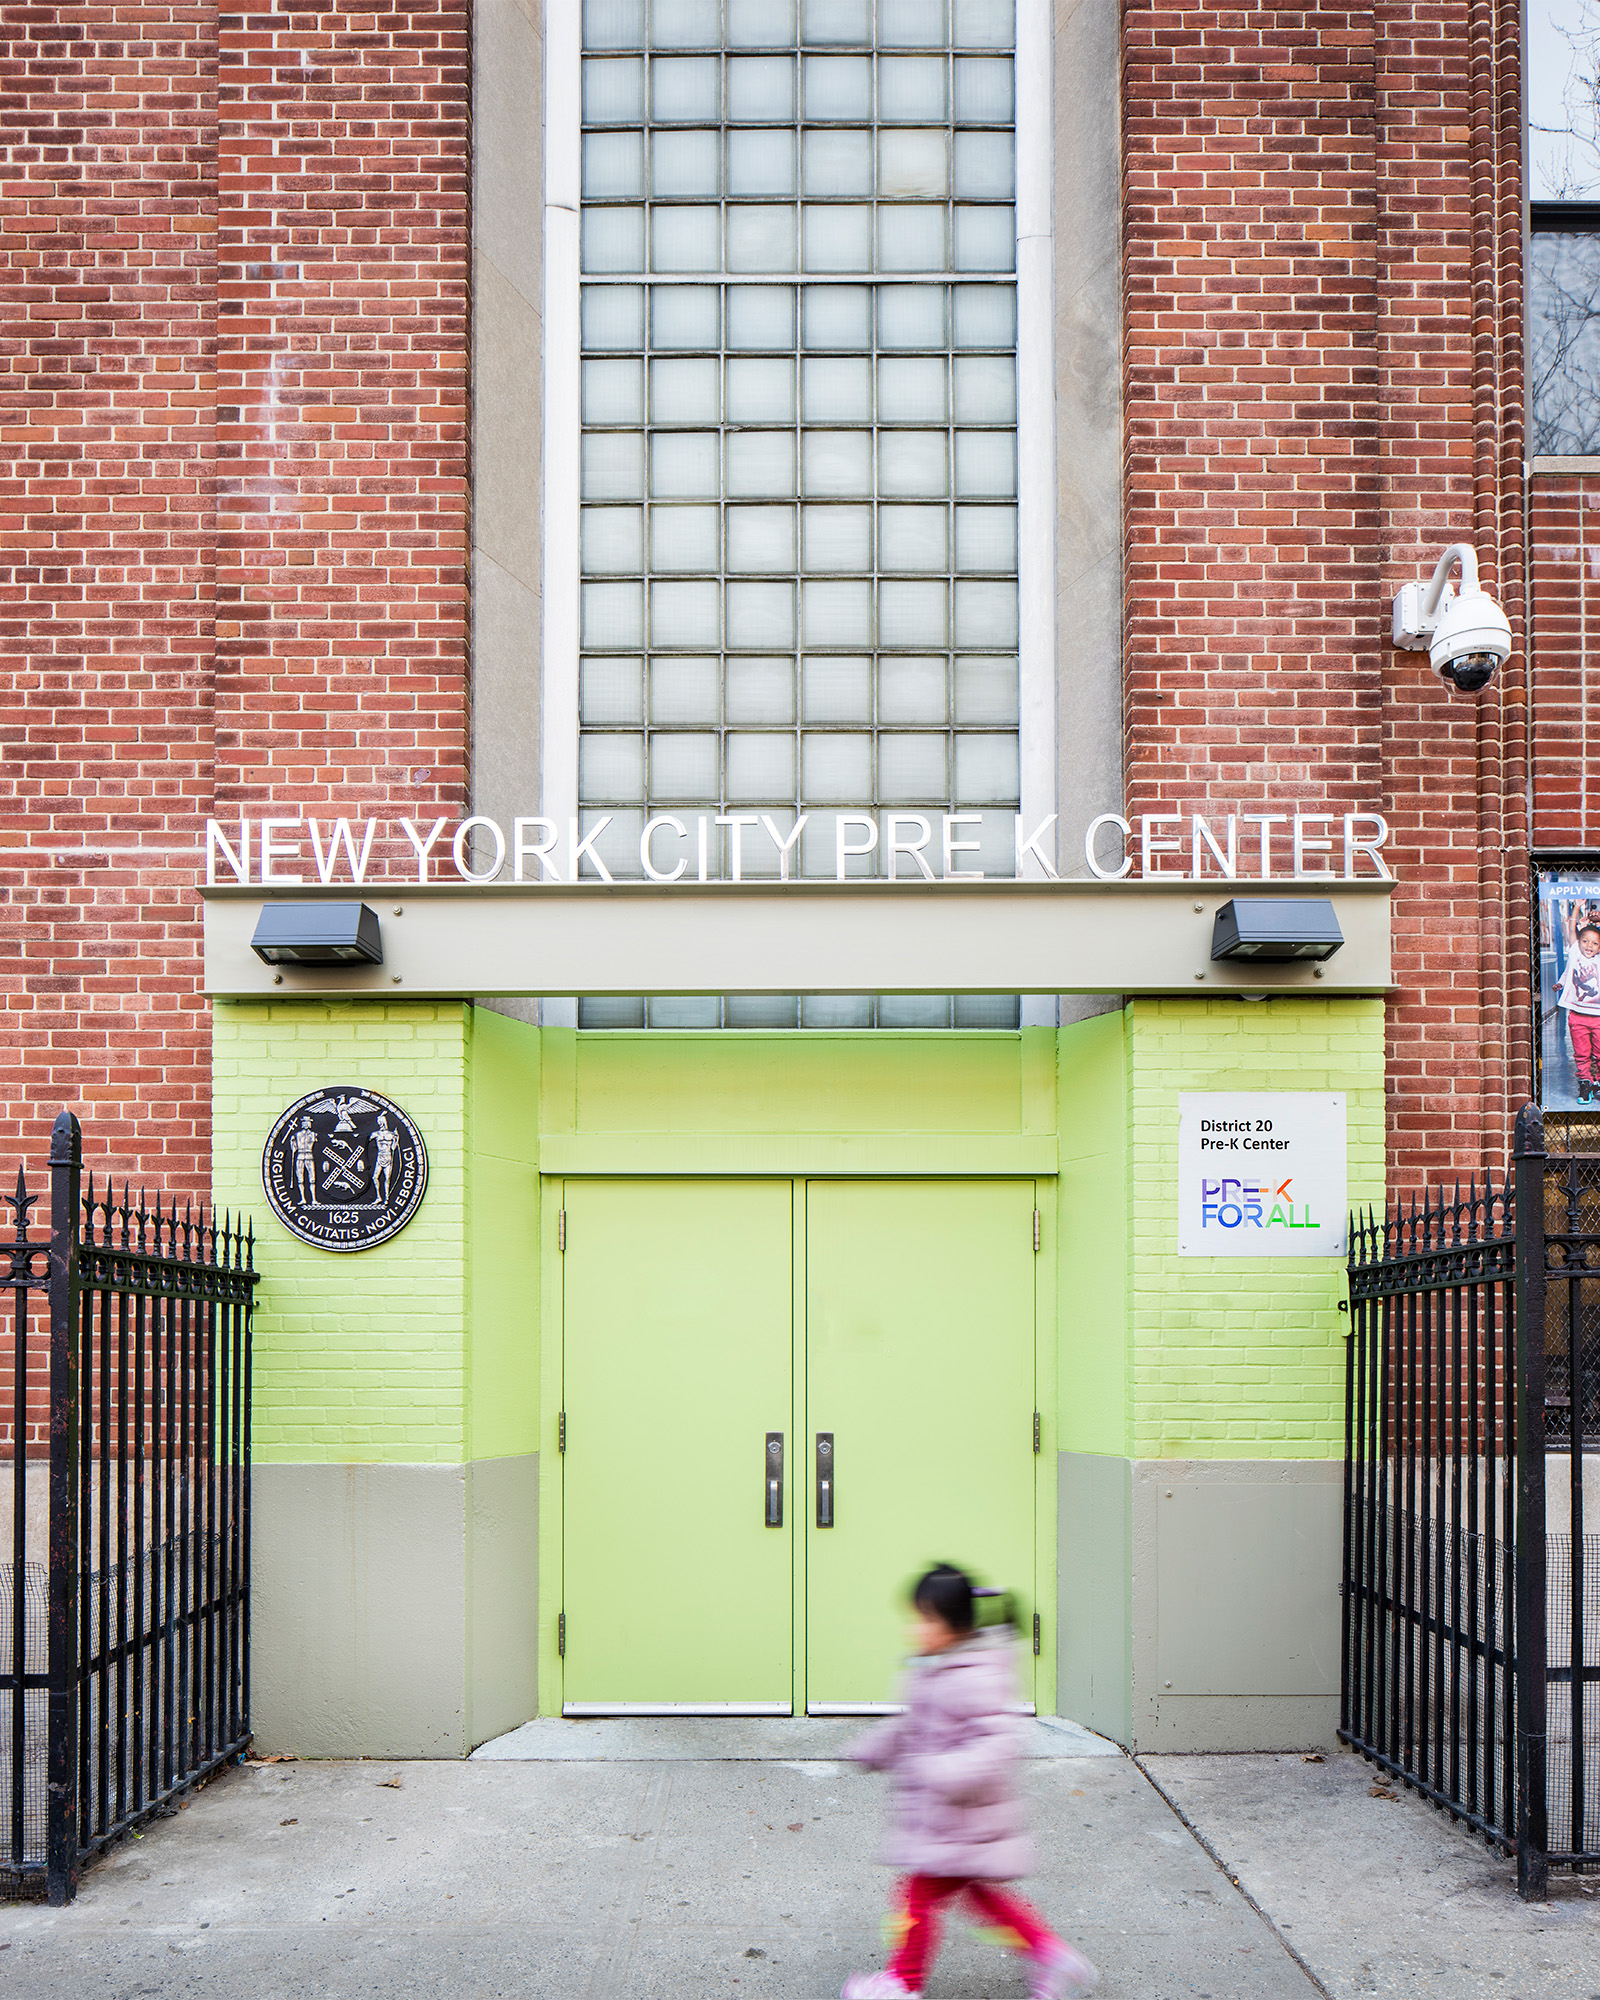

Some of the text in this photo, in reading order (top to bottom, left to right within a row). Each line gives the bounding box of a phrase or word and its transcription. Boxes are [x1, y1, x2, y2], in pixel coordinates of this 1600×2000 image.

[206, 813, 1394, 884] NEW YORK CITY PRE K CENTER
[1550, 886, 1583, 895] APPLY
[1201, 1119, 1273, 1132] District 20
[1201, 1138, 1290, 1150] Pre-K Center
[272, 1147, 415, 1239] SIGILLUM CIVITATIS NOVI EBORACI
[1202, 1178, 1294, 1203] PRE-K
[328, 1211, 359, 1224] 1625
[1202, 1203, 1321, 1228] FOR ALL
